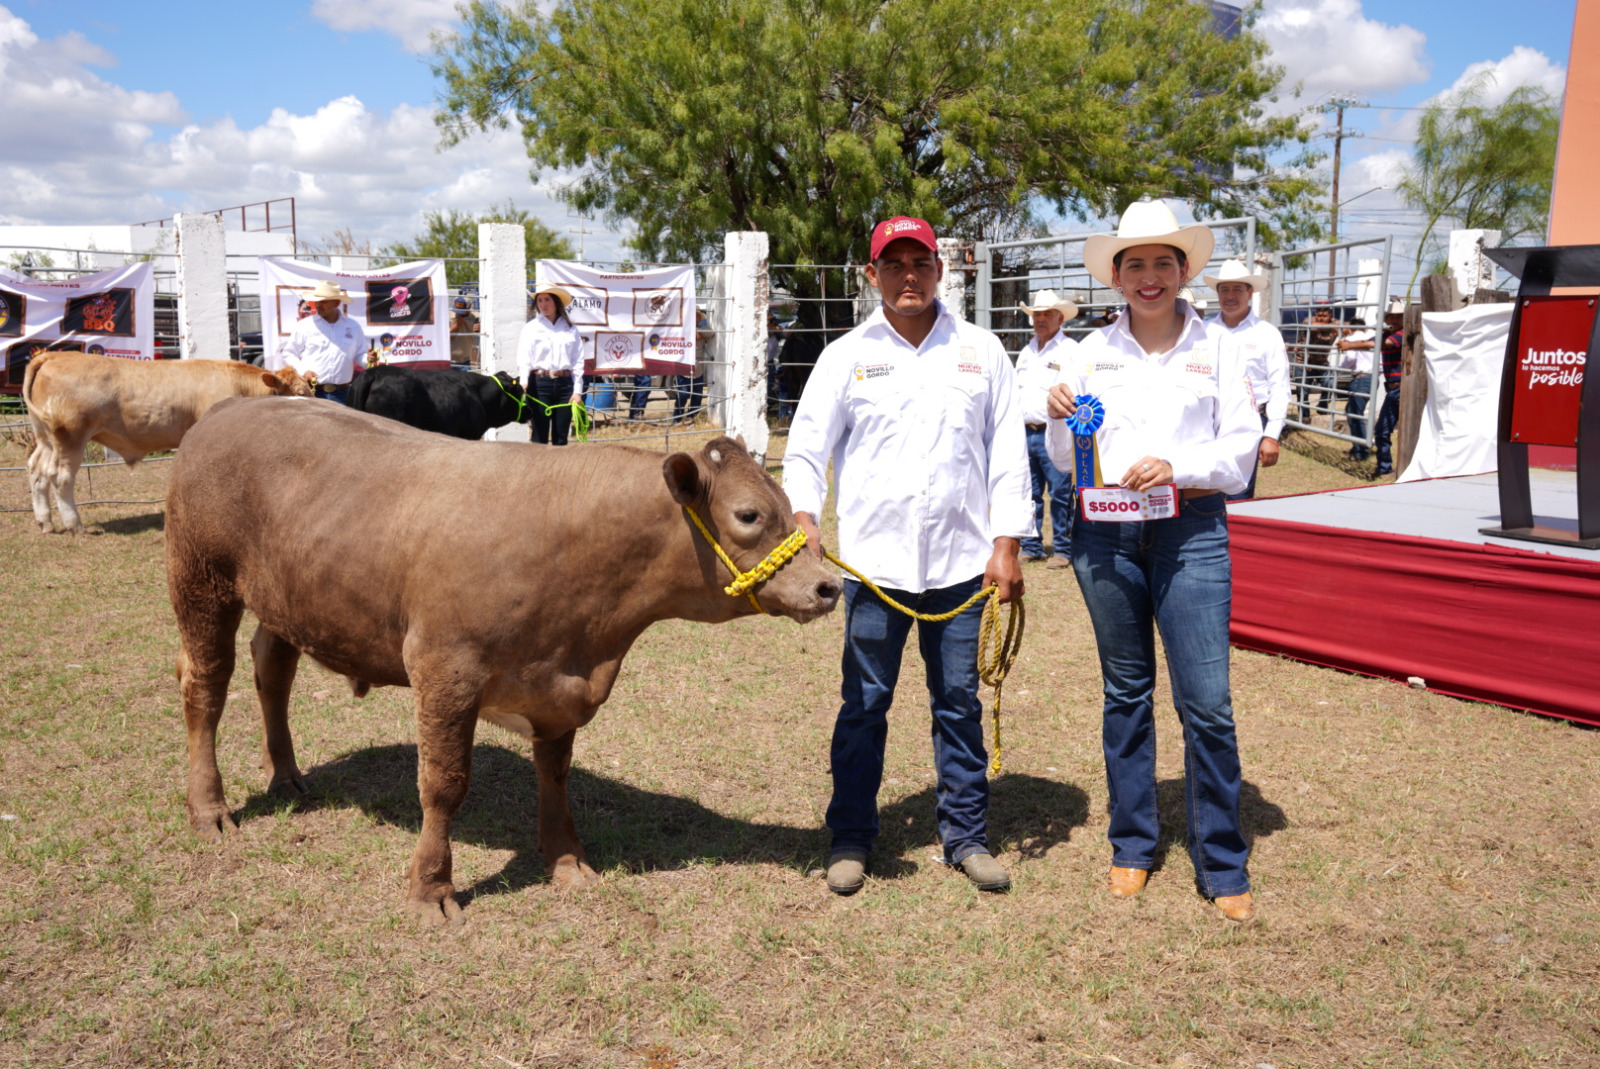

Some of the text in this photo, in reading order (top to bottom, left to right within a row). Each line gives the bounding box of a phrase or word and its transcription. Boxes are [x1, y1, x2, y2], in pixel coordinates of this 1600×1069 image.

[572, 299, 602, 309] ALAMO
[83, 316, 116, 332] BBQ
[1521, 348, 1586, 364] Juntos
[1186, 363, 1212, 371] NUEVO
[1528, 367, 1584, 390] posible
[1088, 501, 1140, 513] $5000
